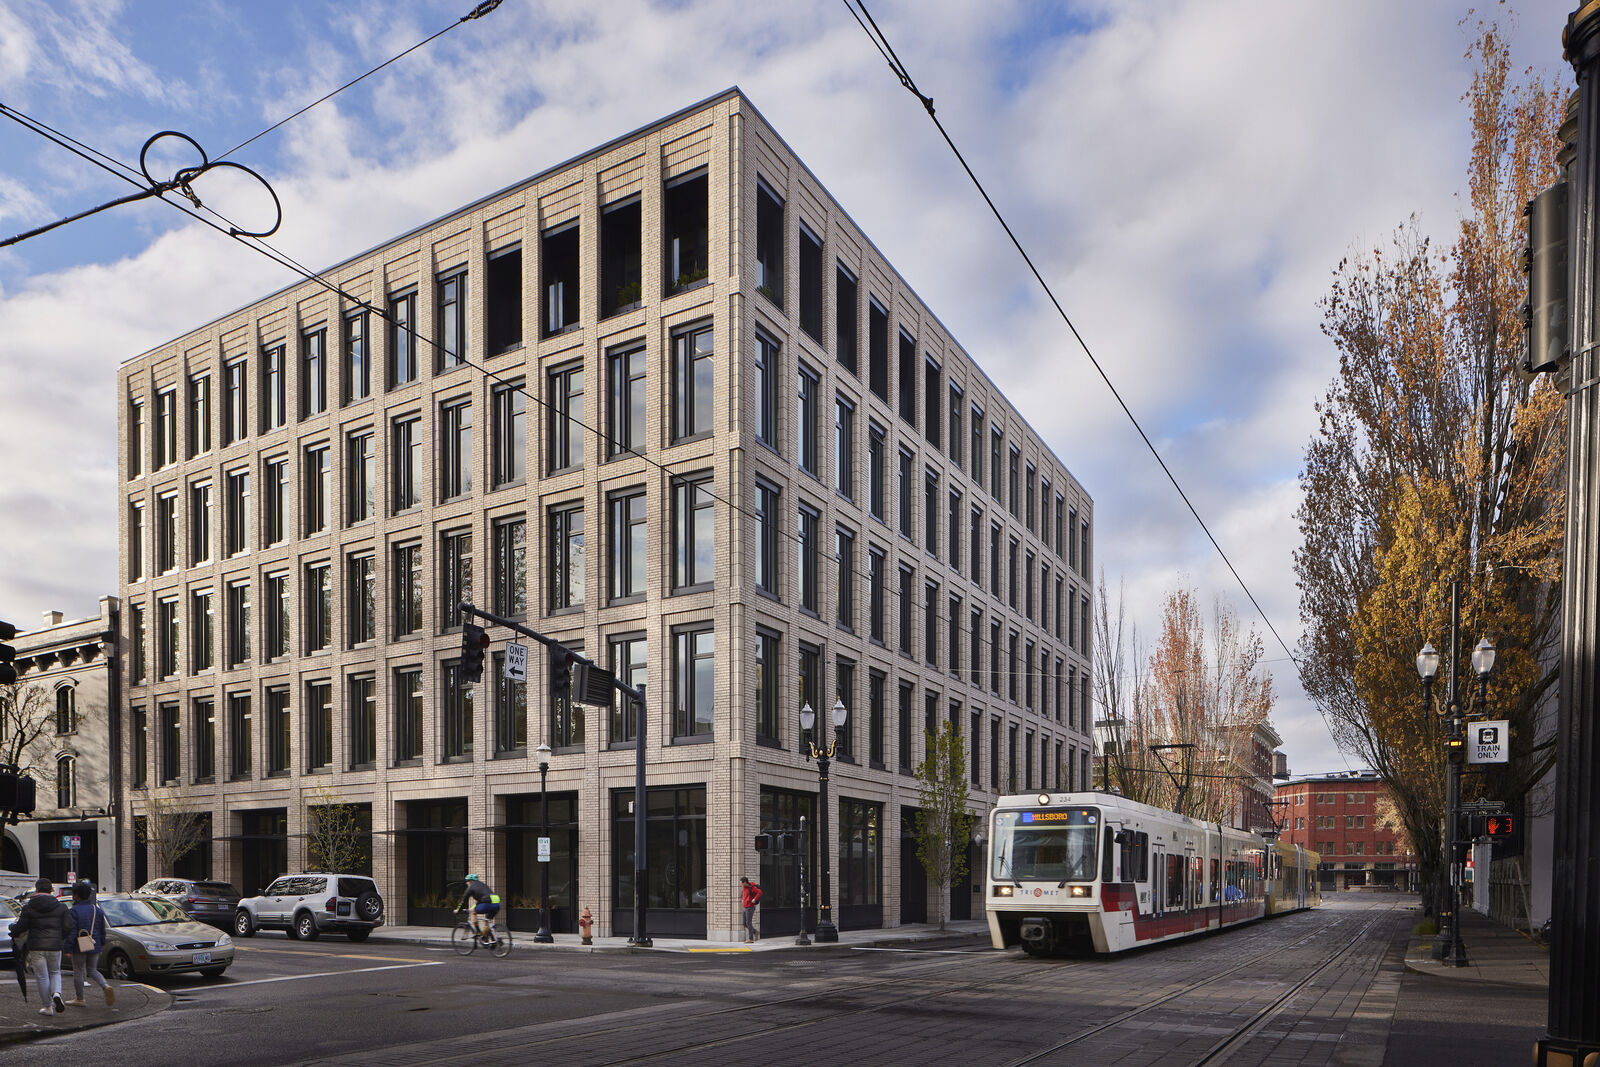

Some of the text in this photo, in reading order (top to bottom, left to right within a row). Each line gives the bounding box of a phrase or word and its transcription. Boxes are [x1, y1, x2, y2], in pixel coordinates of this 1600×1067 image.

[510, 646, 524, 656] ONE
[509, 655, 524, 666] WAY
[1476, 745, 1500, 753] TRAIN
[1032, 813, 1068, 821] HILLSBORO
